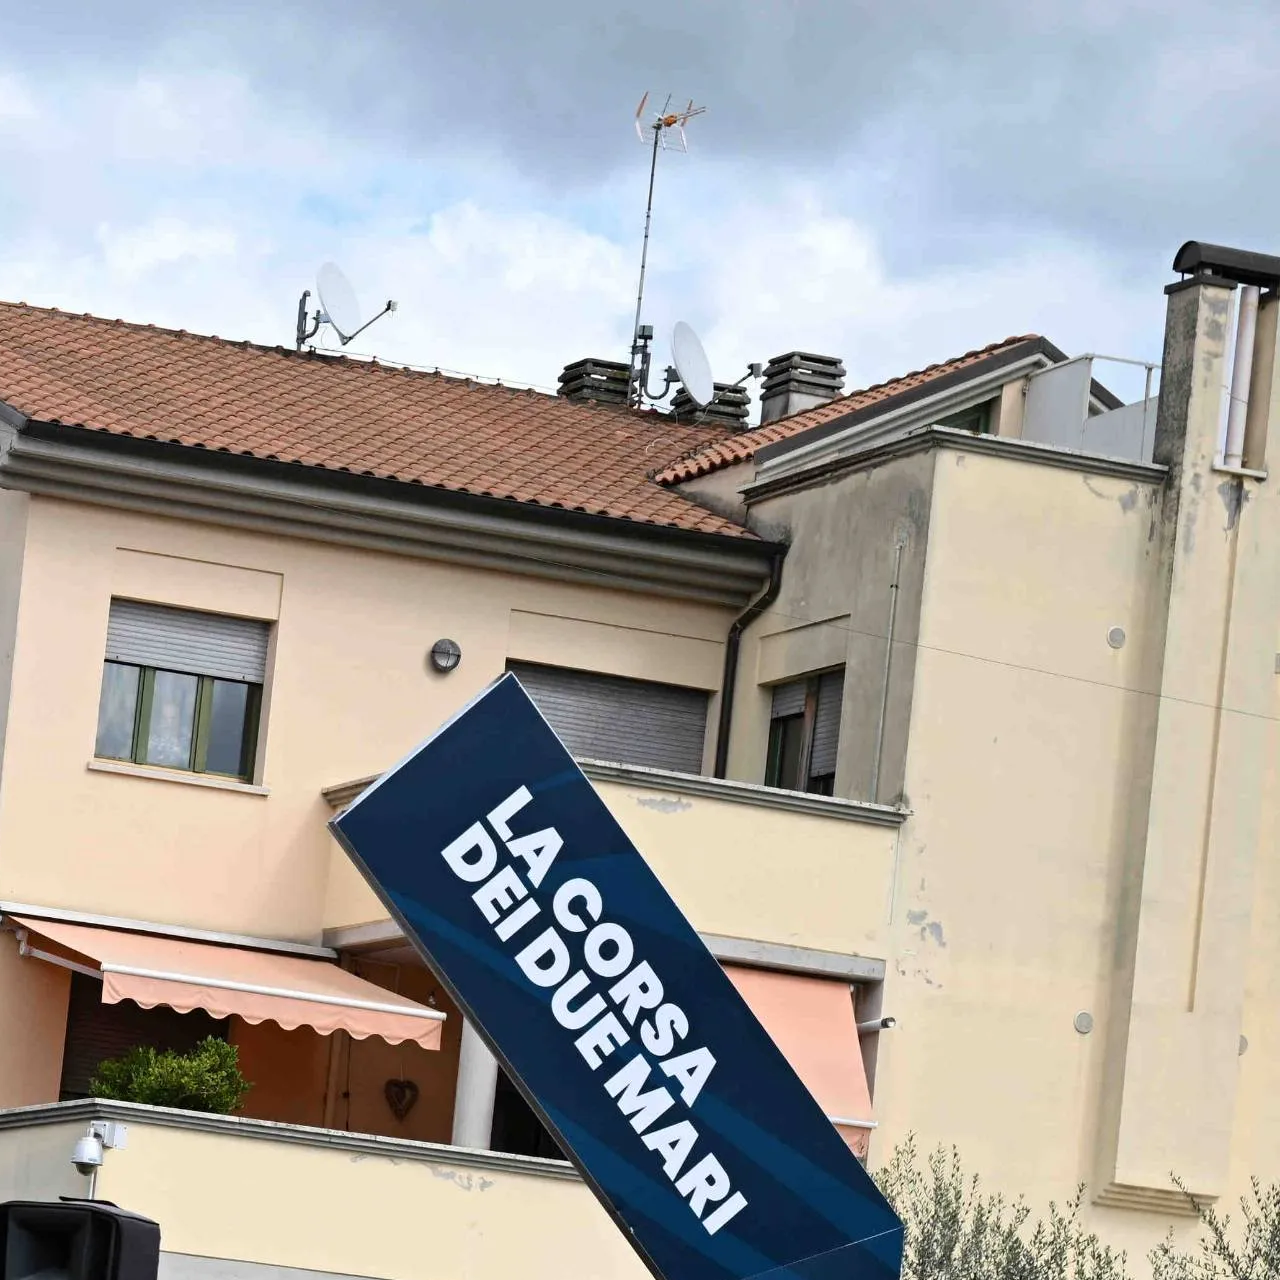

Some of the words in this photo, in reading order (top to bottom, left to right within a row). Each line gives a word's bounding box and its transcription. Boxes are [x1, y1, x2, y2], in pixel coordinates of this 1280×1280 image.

[441, 820, 542, 942] DEI
[513, 926, 632, 1071] DUE
[603, 1053, 749, 1237] MARI
[486, 784, 565, 889] LA
[552, 877, 718, 1108] CORSA
